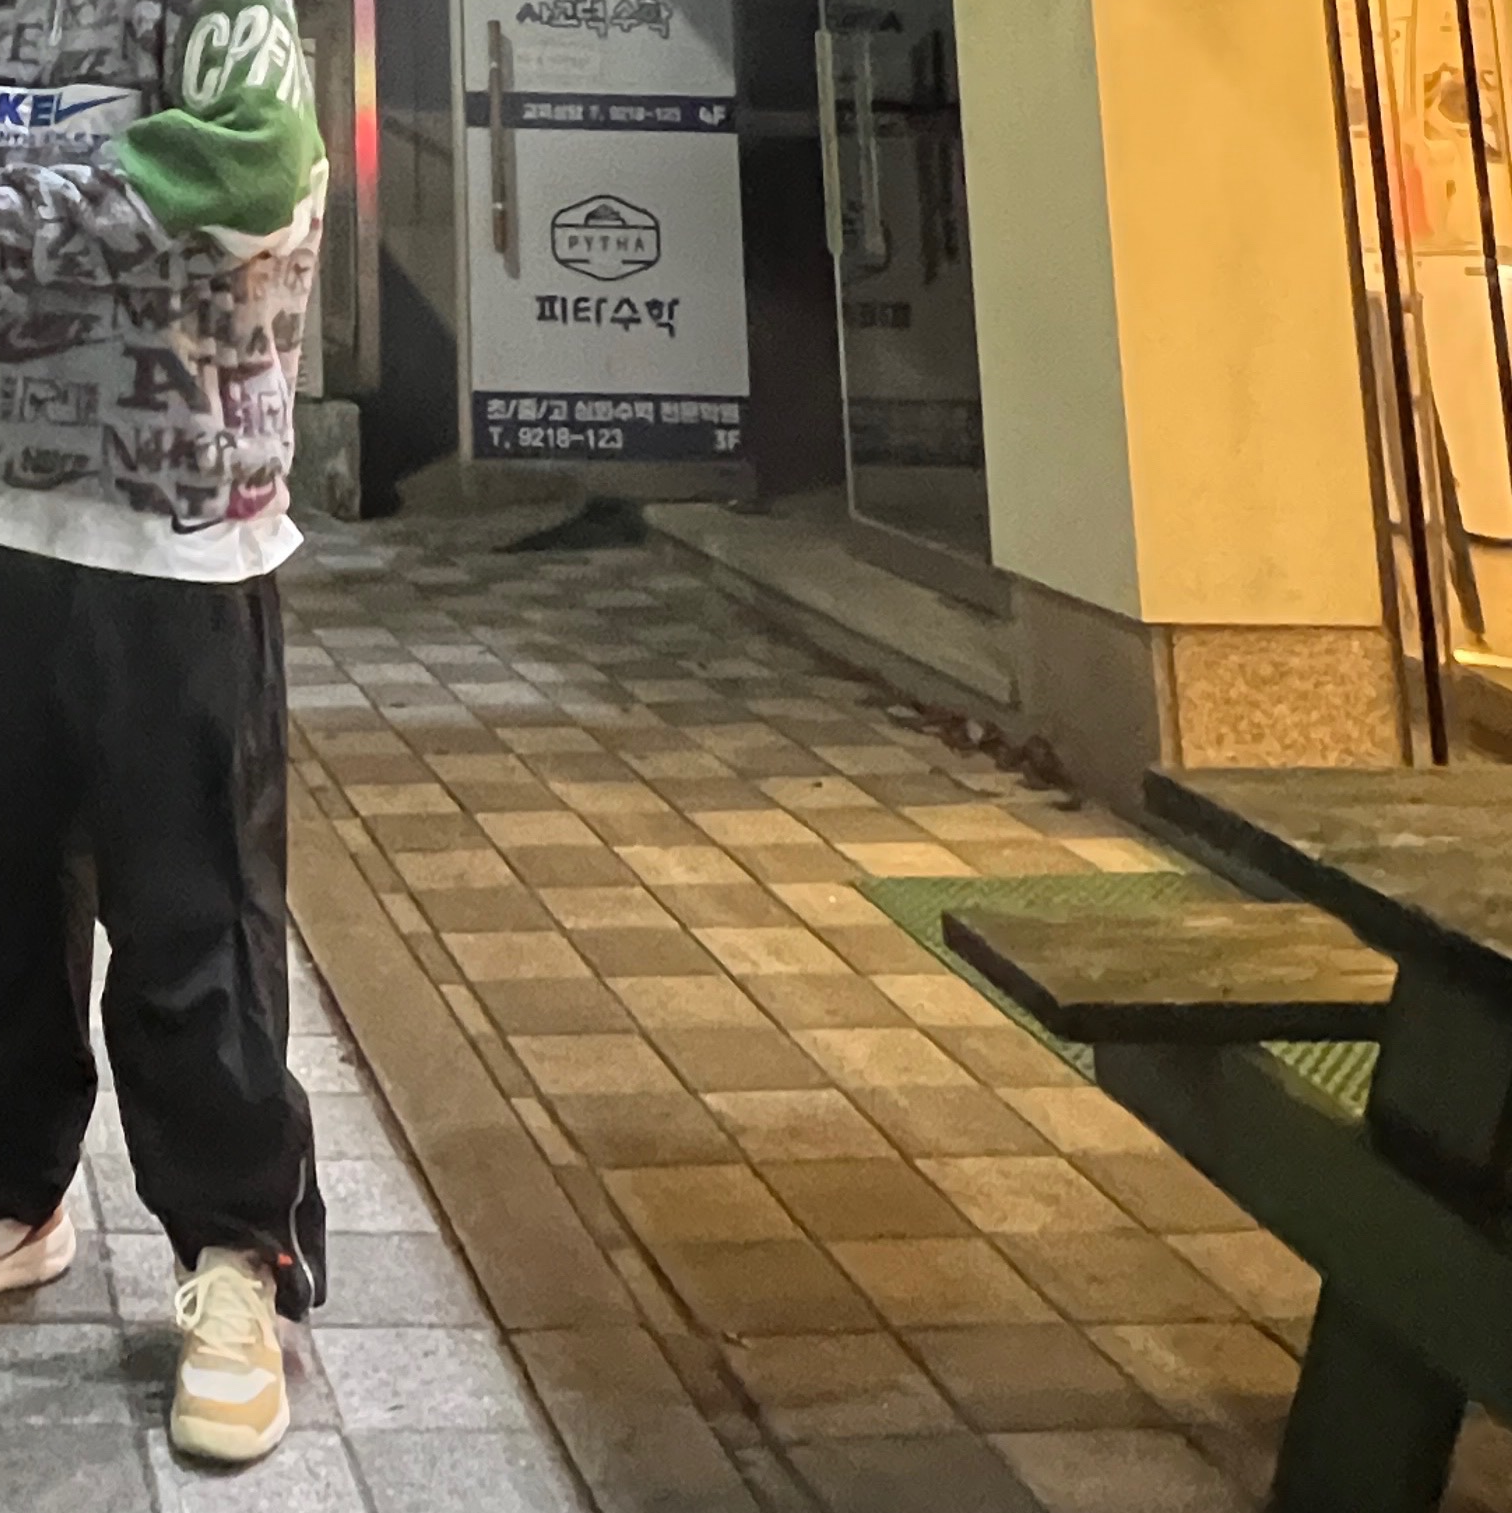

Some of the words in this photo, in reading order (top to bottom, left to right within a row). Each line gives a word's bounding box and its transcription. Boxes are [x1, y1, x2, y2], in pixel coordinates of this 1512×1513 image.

[568, 235, 645, 251] PYTHA
[535, 294, 680, 338] 피타수학
[518, 427, 624, 449] 9218-123
[714, 429, 740, 450] 3F
